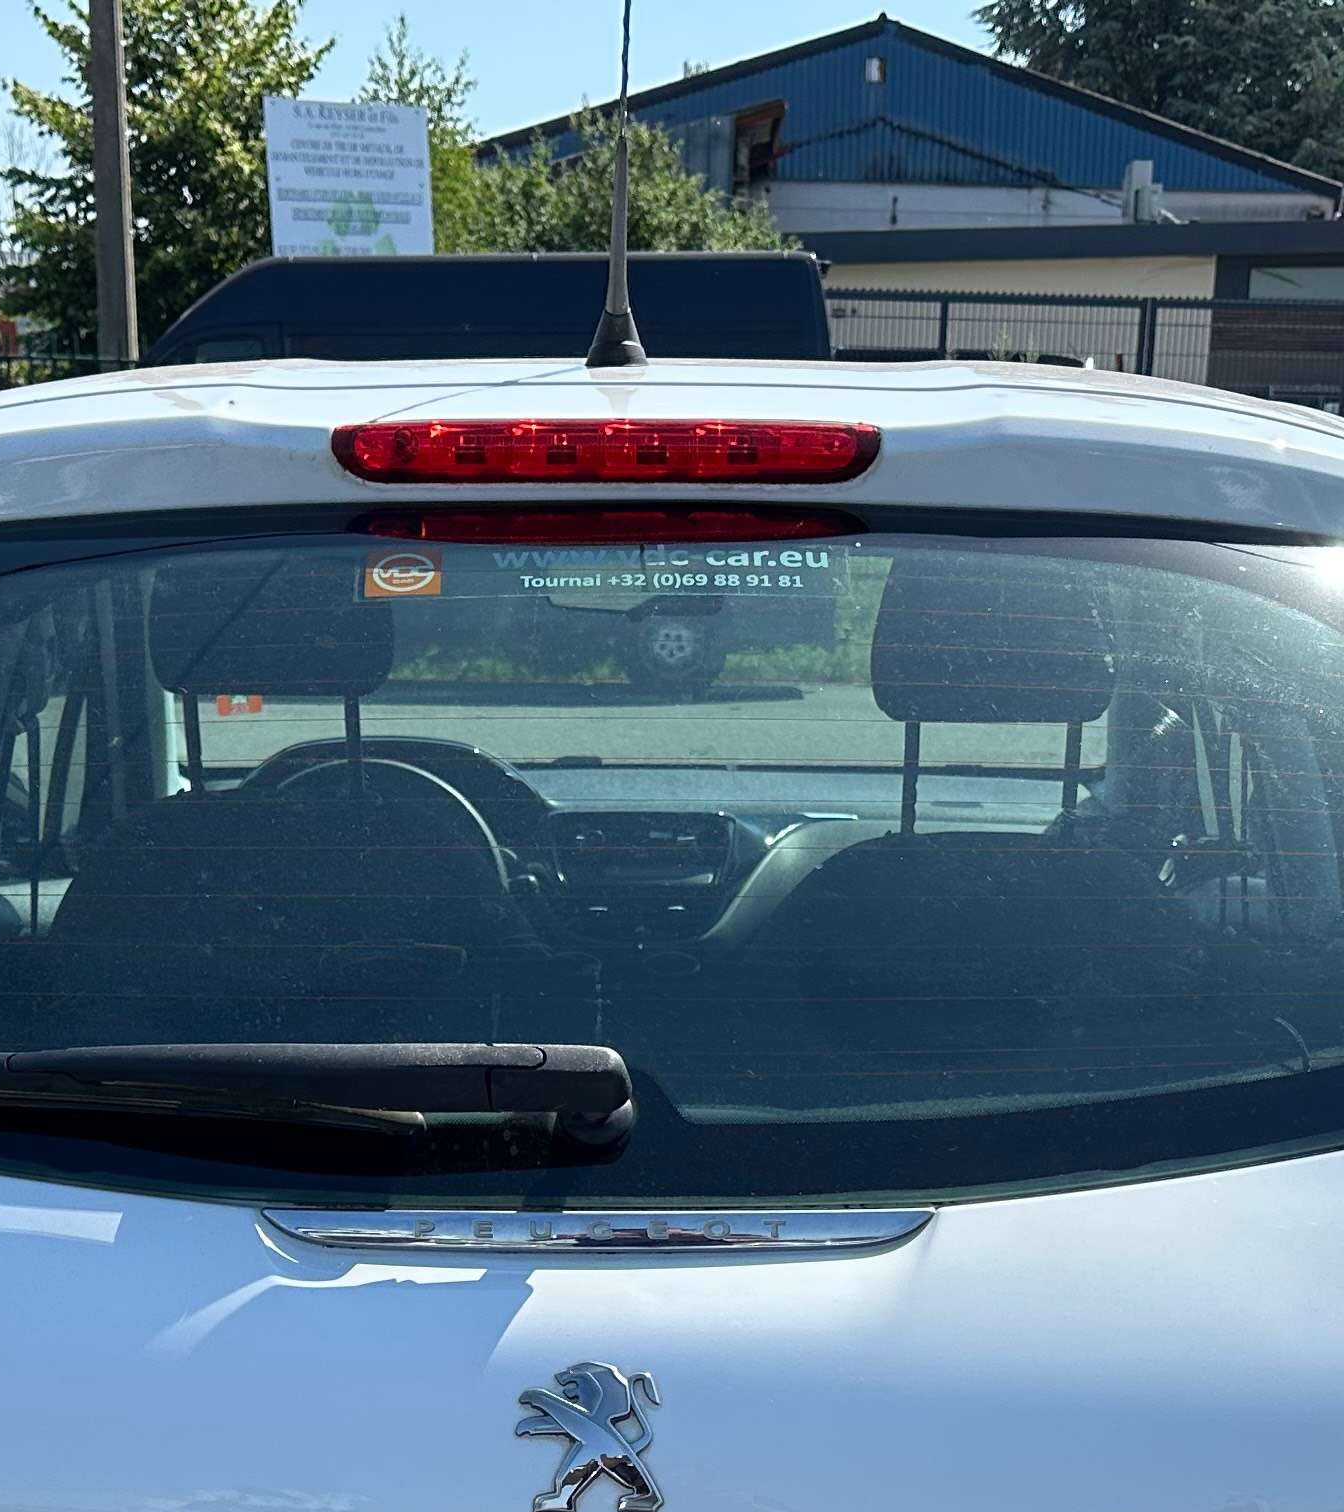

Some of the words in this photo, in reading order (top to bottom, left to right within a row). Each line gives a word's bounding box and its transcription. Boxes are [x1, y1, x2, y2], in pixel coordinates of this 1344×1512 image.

[493, 545, 829, 568] www.vdc-car.eu
[521, 573, 601, 588] Tournai
[607, 574, 646, 588] +32
[653, 573, 708, 589] (0)69
[714, 574, 740, 587] 88
[747, 574, 772, 587] 91
[778, 574, 804, 587] 81
[413, 1219, 787, 1241] PEUGEOT
